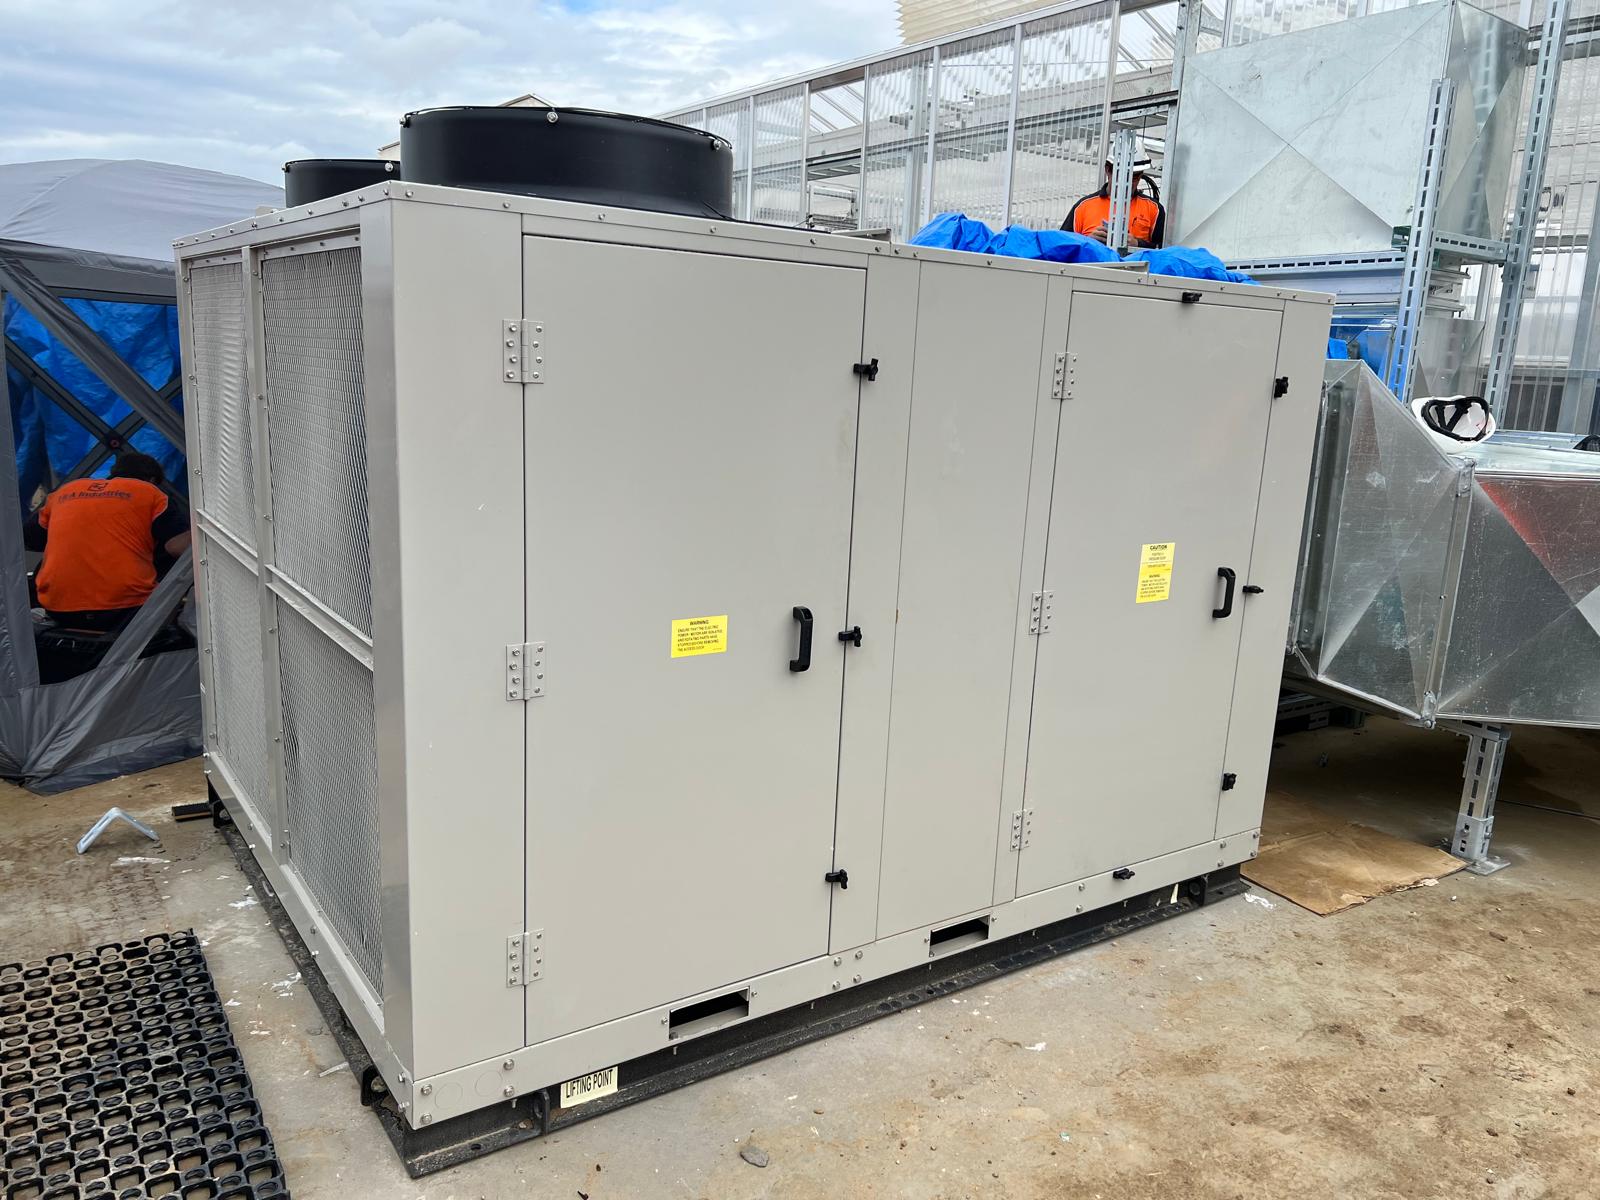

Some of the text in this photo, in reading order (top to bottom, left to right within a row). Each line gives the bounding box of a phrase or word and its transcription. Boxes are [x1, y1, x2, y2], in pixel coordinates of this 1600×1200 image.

[78, 490, 132, 499] Industries
[566, 1069, 613, 1098] LIFTING POINT
